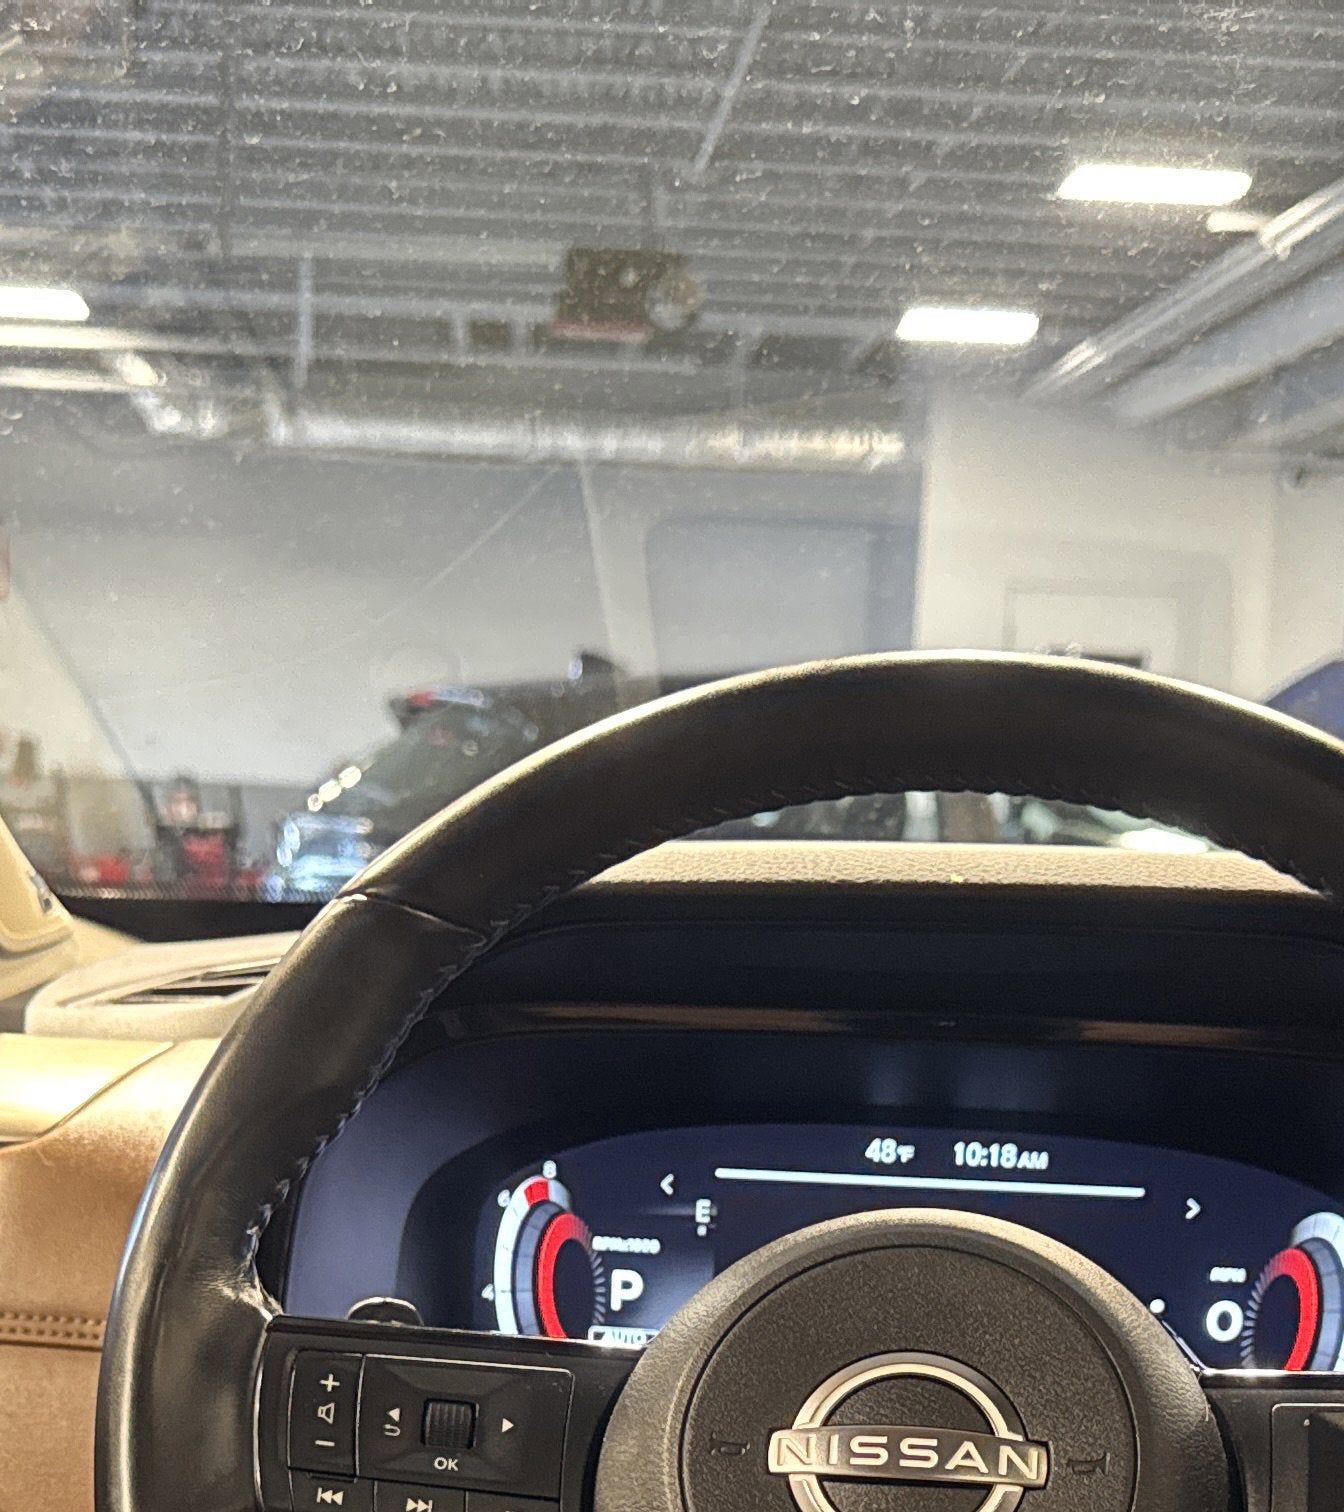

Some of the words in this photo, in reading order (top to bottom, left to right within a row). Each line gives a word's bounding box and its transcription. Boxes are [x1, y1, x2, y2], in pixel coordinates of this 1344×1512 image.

[695, 1198, 712, 1224] E
[610, 1269, 644, 1312] P
[433, 1456, 459, 1472] OK
[776, 1433, 1039, 1480] NISSAN
